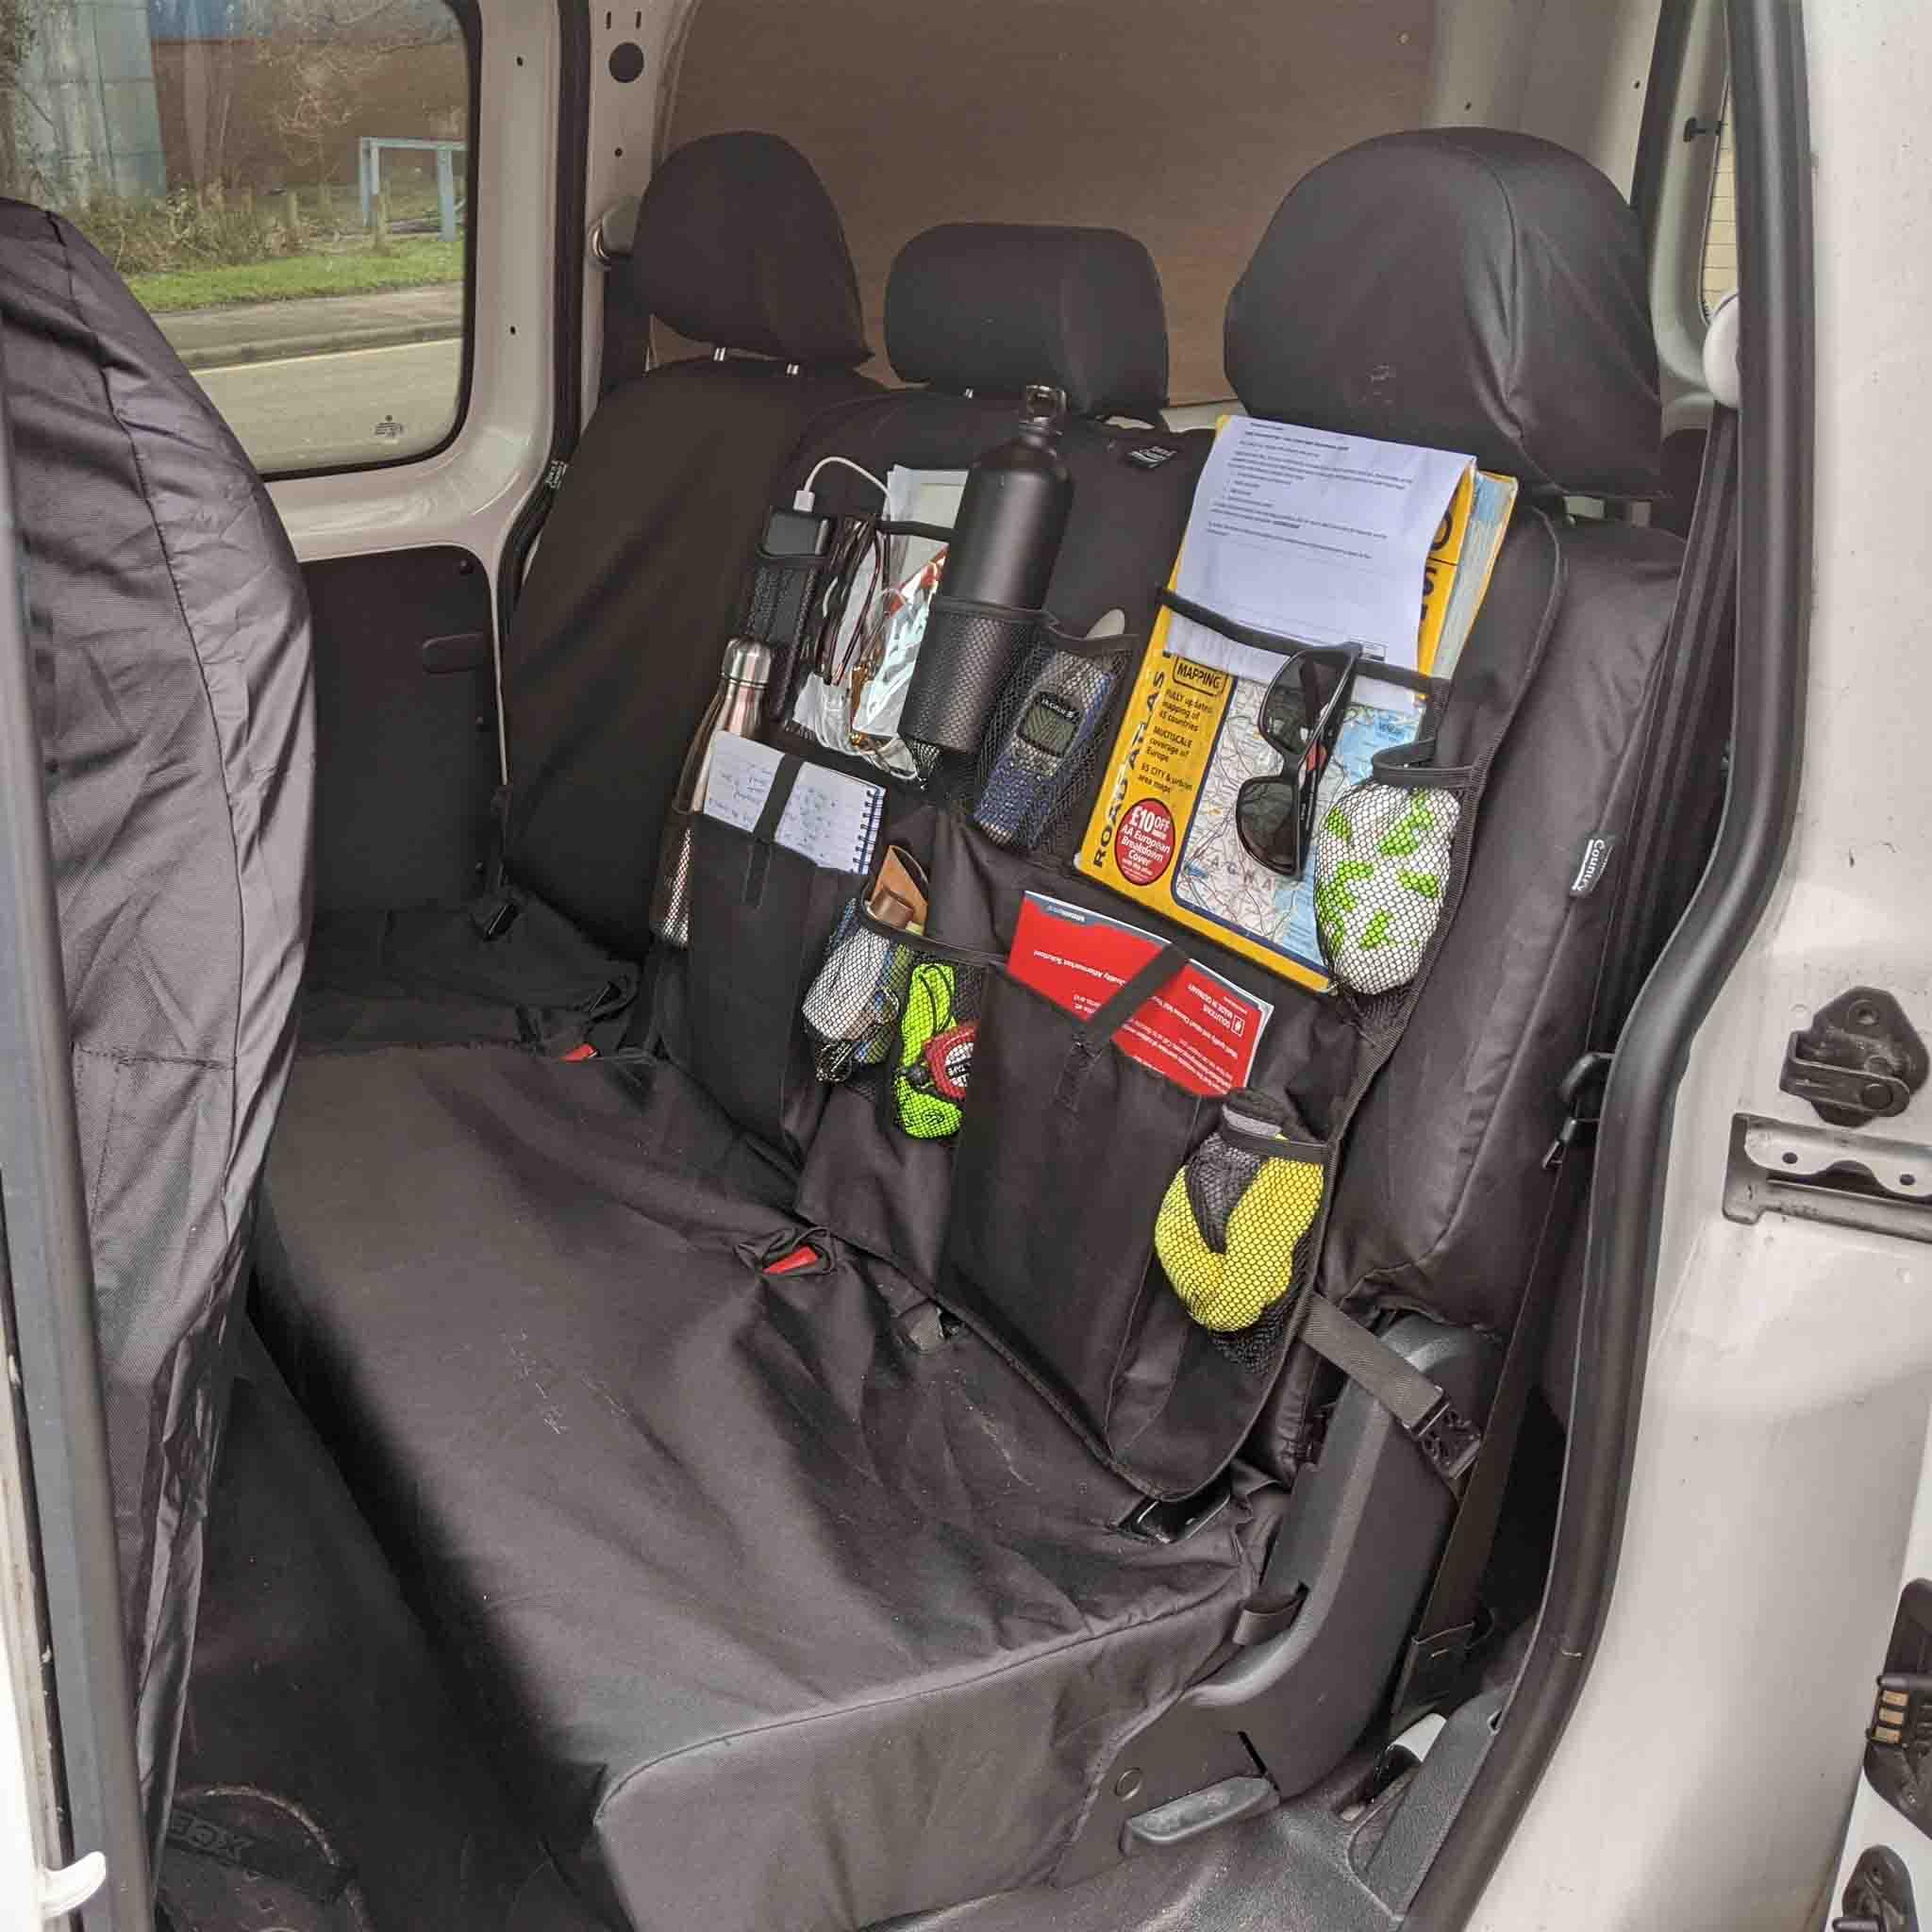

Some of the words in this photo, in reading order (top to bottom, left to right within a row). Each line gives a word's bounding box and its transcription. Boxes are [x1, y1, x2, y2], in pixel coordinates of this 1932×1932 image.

[1176, 662, 1223, 689] MAPPING
[1167, 713, 1199, 732] countries
[1146, 748, 1170, 763] Europe
[1149, 738, 1179, 757] coverage
[1093, 778, 1127, 868] ROAD
[1128, 671, 1165, 770] ATLAS
[1151, 767, 1167, 780] CITY
[1129, 806, 1155, 832] £10
[1155, 817, 1170, 831] OFF
[1121, 837, 1163, 861] Breakdown
[1122, 824, 1134, 836] AA
[1134, 830, 1171, 854] European
[1576, 839, 1605, 891] Country
